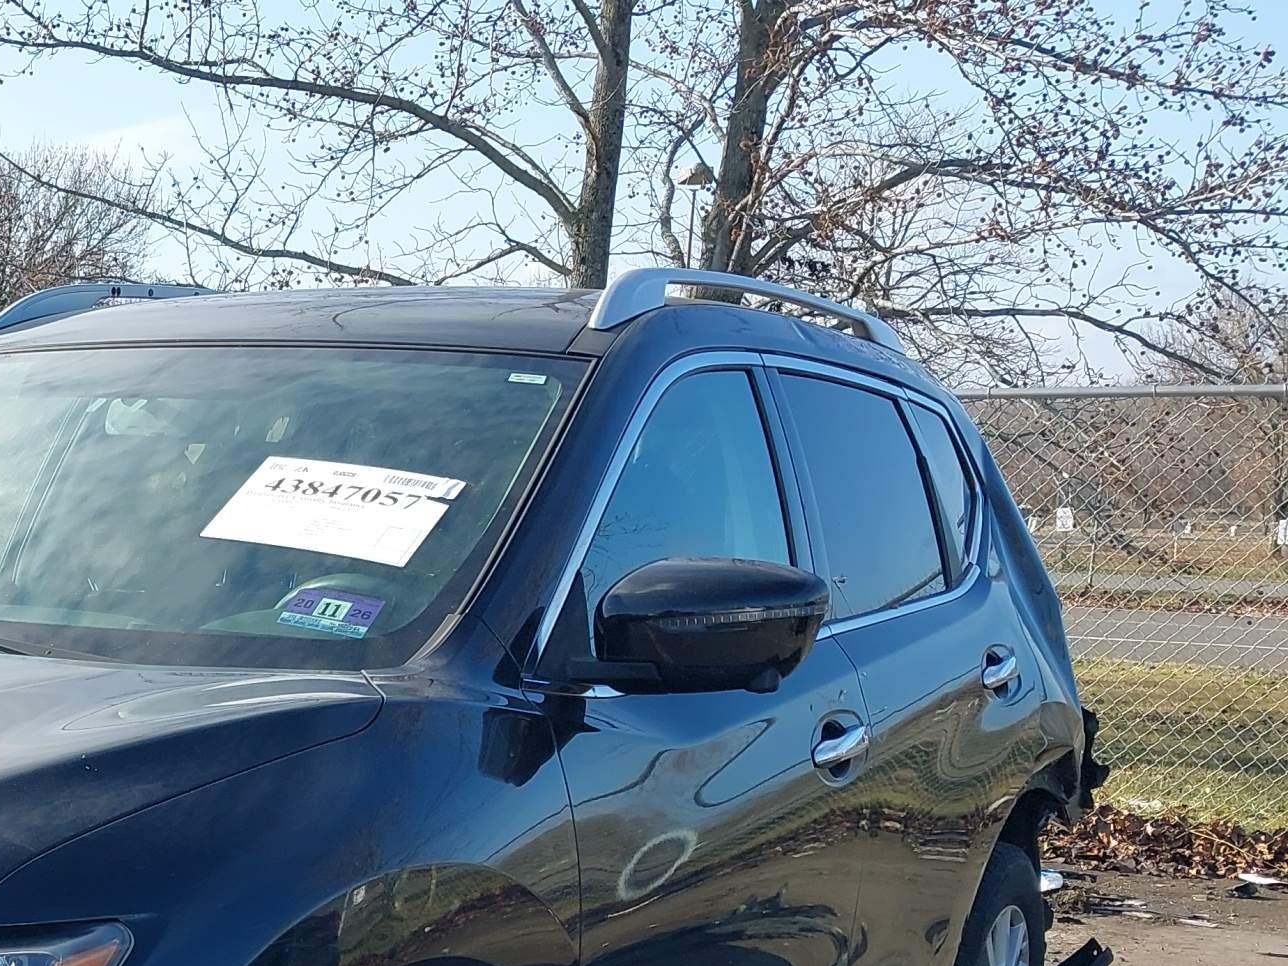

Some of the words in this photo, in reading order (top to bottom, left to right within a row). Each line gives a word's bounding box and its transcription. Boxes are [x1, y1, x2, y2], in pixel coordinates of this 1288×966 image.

[264, 477, 422, 511] 43847057
[294, 598, 315, 610] 20
[318, 601, 342, 617] 11
[350, 608, 373, 621] 26
